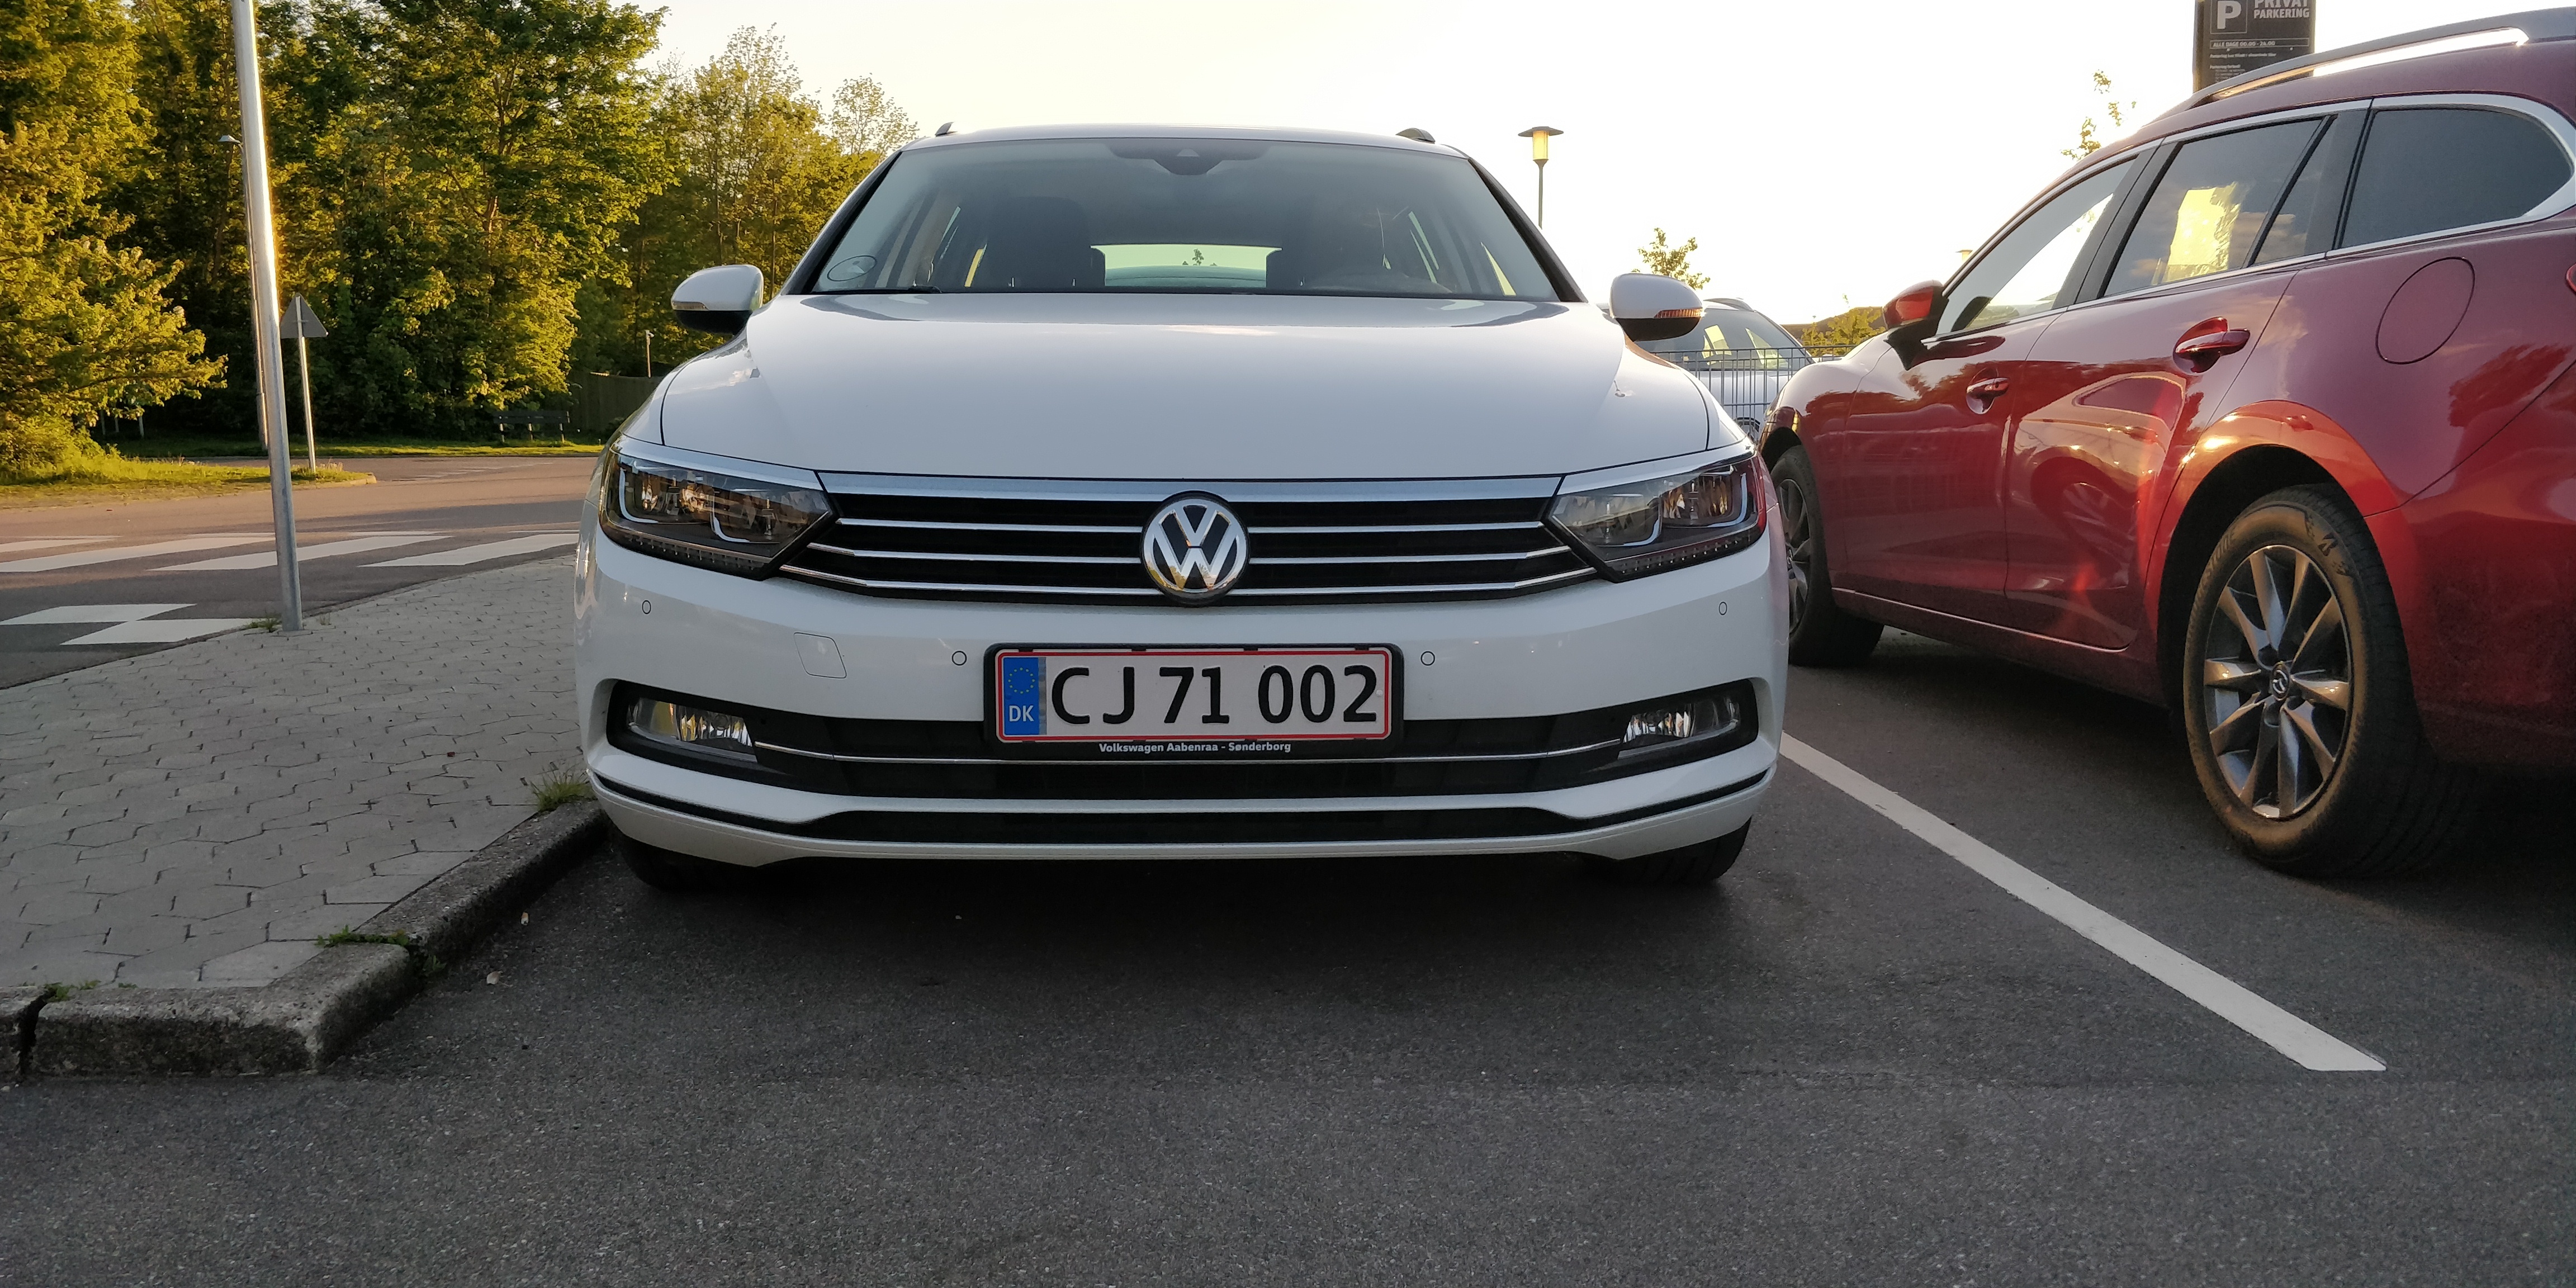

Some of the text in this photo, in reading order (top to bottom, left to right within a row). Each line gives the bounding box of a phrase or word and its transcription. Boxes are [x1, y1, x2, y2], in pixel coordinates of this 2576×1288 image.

[2217, 1, 2242, 29] P
[2253, 8, 2310, 18] PARKERING
[1148, 501, 1242, 592] VW
[1052, 665, 1377, 724] CJ 71 002
[1009, 705, 1034, 722] DK
[1099, 743, 1164, 754] Volkswagen
[1167, 742, 1218, 752] Aabenraa
[1228, 742, 1291, 752] Sønderborg
